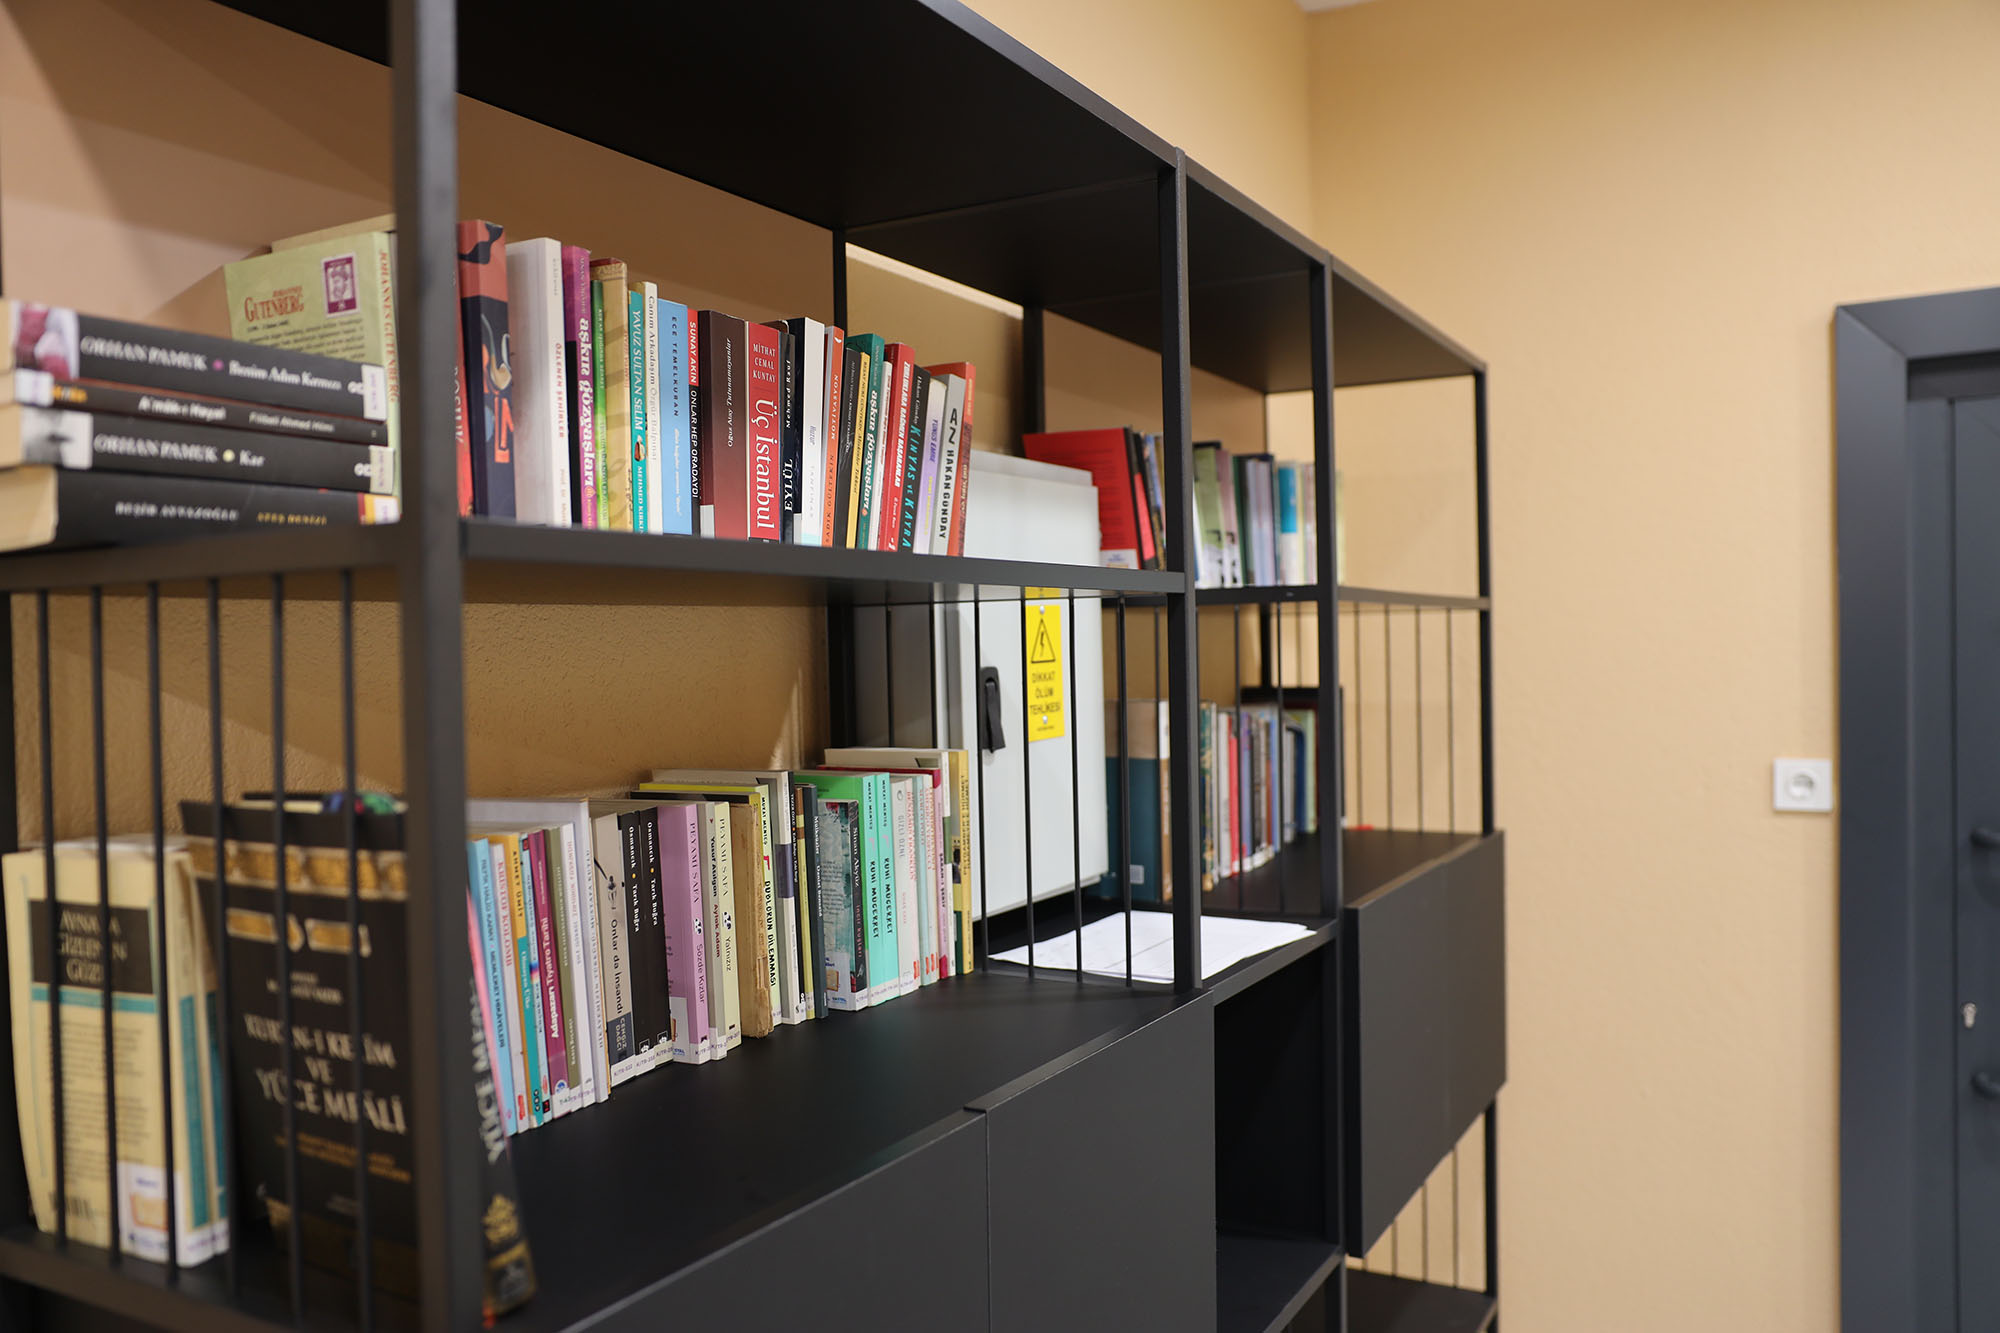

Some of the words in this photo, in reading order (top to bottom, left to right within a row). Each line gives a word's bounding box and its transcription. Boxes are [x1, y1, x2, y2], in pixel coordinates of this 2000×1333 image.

[244, 294, 305, 322] GUTENBERG
[648, 295, 656, 328] Canım
[632, 309, 642, 346] YAVUZ
[689, 320, 698, 356] SUNAY
[80, 335, 148, 361] ORHAN
[148, 346, 208, 371] PAMUK
[578, 317, 592, 376] aşkın
[649, 330, 657, 384] Arkadaşım
[754, 356, 775, 370] CEMAL
[632, 347, 644, 397] SULTAN
[672, 342, 680, 417] TEMELKURAN
[690, 356, 699, 385] AKIN
[690, 389, 700, 425] ONLAR
[751, 399, 778, 429] Üç
[898, 406, 908, 438] RAĞMEN
[580, 379, 596, 487] gözyaşları
[691, 426, 700, 448] HEP
[930, 418, 939, 442] YUNUS
[94, 432, 160, 457] ORHAN
[159, 440, 218, 462] PAMUK
[239, 449, 266, 467] Kar
[894, 437, 905, 488] BAŞARANLAR
[929, 441, 937, 463] EMRE
[755, 433, 778, 529] İstanbul
[782, 458, 793, 511] EYLÜL
[863, 432, 876, 510] gözyaşları
[944, 449, 954, 490] HAKAN
[902, 497, 915, 548] KAYRA
[628, 825, 637, 869] Osmancık
[647, 821, 655, 864] Osmancık
[710, 836, 718, 861] Yusuf
[852, 826, 860, 856] Sinan
[512, 850, 522, 887] AHMET
[711, 862, 719, 898] Atılgan
[722, 865, 730, 897] SAFA
[854, 857, 862, 889] Akyüz
[869, 860, 878, 884] RUHİ
[883, 857, 892, 879] RUHİ
[516, 889, 526, 918] ÜMİT
[632, 883, 640, 907] Tarık
[650, 877, 658, 900] Tarık
[693, 871, 701, 904] SAFA
[540, 916, 551, 947] Tarihi
[713, 903, 721, 930] Aylak
[501, 914, 514, 967] KOLOMB
[610, 918, 620, 952] Onlar
[544, 948, 557, 987] Tiyatro
[613, 953, 621, 969] da
[696, 943, 705, 973] Sözde
[724, 936, 733, 972] Yalnızız
[767, 934, 777, 987] DİLEMMASI
[490, 950, 500, 997] MEMLEKET
[699, 974, 707, 1005] Kızlar
[549, 986, 561, 1039] Adapazarı
